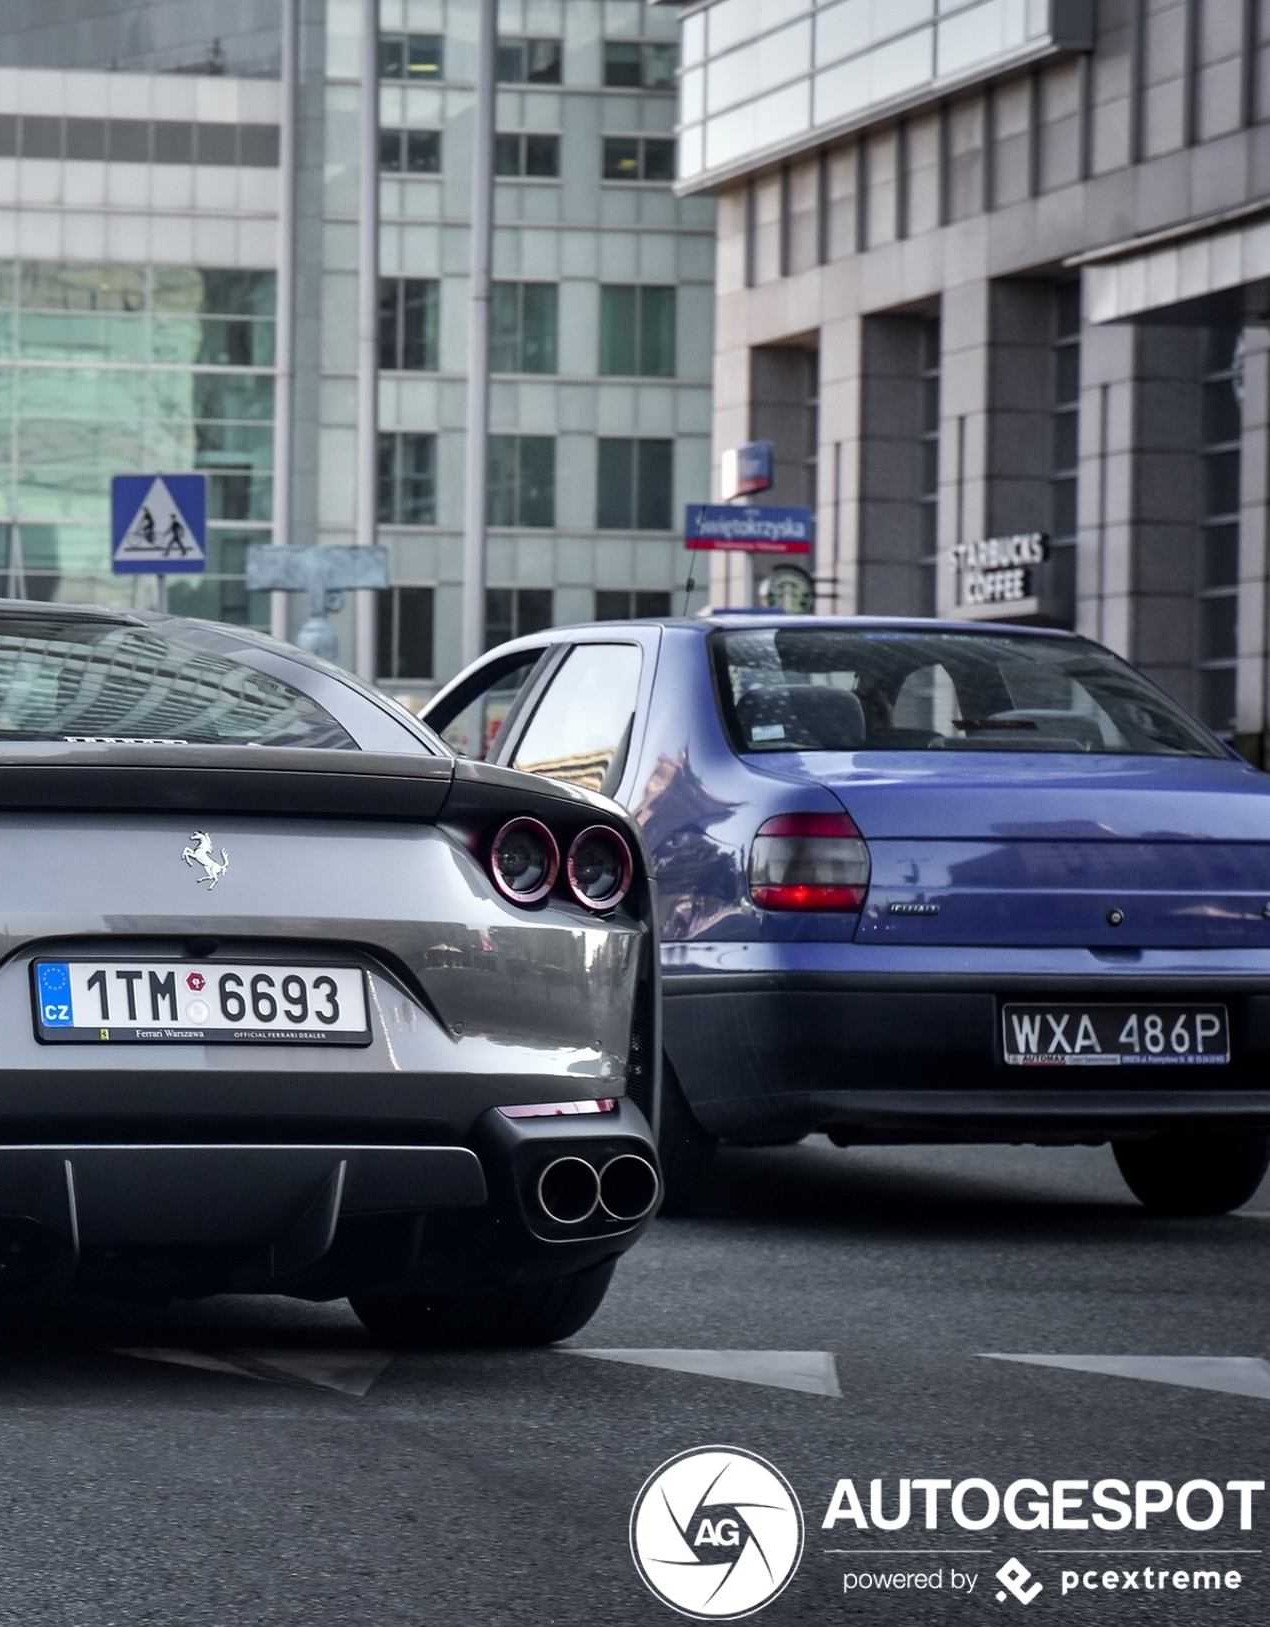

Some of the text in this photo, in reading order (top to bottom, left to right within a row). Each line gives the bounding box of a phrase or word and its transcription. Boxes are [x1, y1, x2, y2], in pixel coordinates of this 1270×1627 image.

[948, 532, 1043, 571] STARBUCKS
[965, 568, 1024, 604] COFFEE
[45, 1004, 70, 1020] CZ
[87, 970, 341, 1025] 1TM 6693
[136, 1029, 205, 1039] Ferrari Warszawa
[1011, 1013, 1221, 1053] WXA 486P
